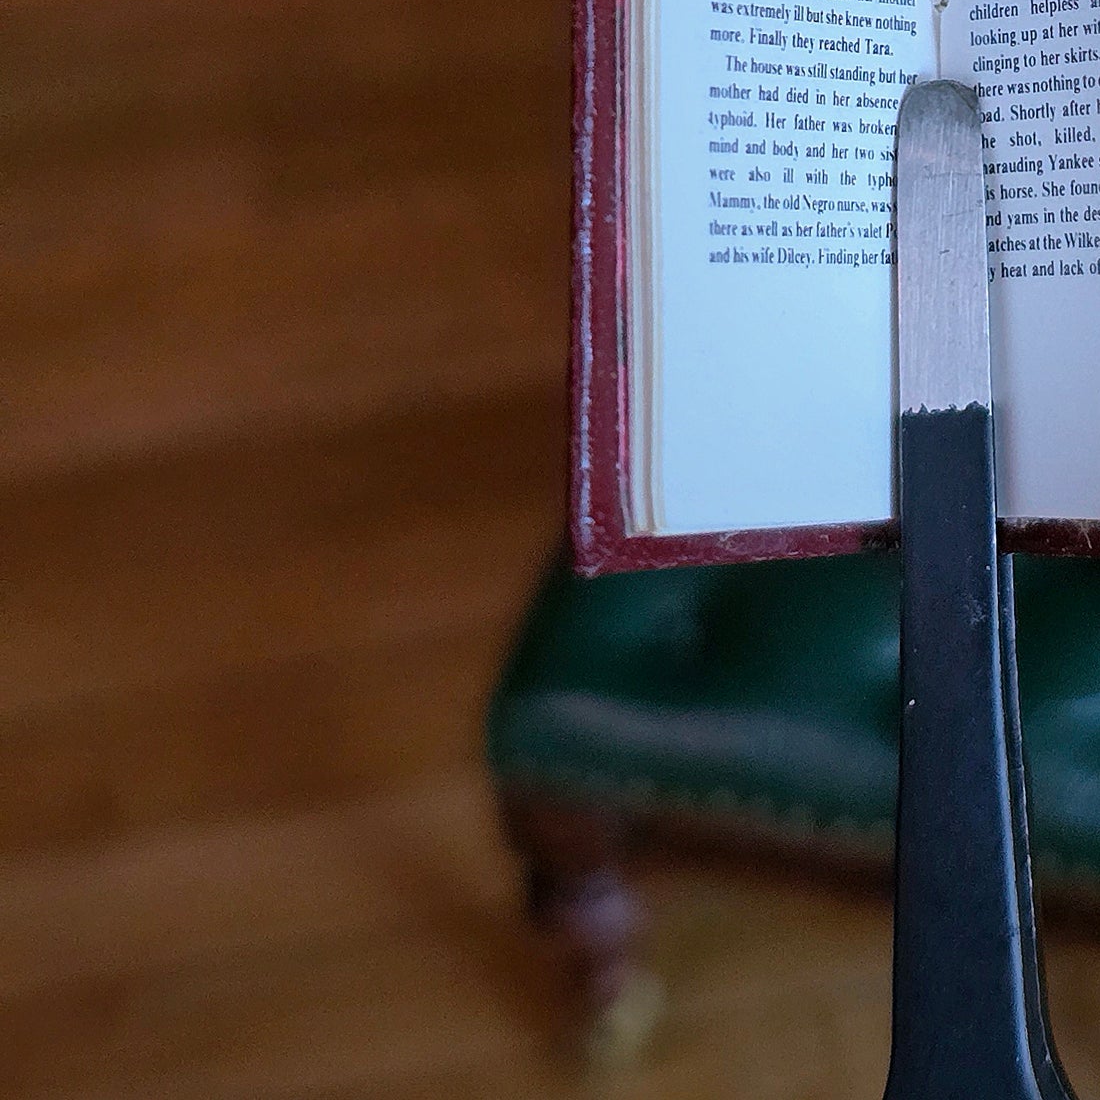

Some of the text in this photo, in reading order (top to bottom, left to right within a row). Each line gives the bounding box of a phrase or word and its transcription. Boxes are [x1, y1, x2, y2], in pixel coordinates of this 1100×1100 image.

[711, 0, 917, 36] was extremely ill but she knew nothing
[969, 3, 1019, 21] children
[709, 27, 894, 56] more. Finally they reached Tara.
[970, 29, 1018, 48] looking
[1021, 29, 1038, 46] up
[1042, 26, 1055, 40] at
[1058, 21, 1079, 38] her
[725, 55, 918, 86] The house was still standing but her
[972, 54, 1020, 75] clinging
[1023, 52, 1037, 69] to
[1040, 49, 1061, 66] her
[709, 83, 899, 109] mother had died in her absence
[973, 80, 1004, 98] there
[1007, 78, 1031, 94] was
[1032, 73, 1080, 94] nothing
[1082, 73, 1096, 89] to
[708, 111, 897, 136] typhoid. Her father was broken
[1010, 102, 1056, 123] Shortly
[1062, 101, 1091, 118] after
[709, 137, 739, 154] mind
[745, 139, 766, 155] and
[772, 140, 799, 161] body
[805, 143, 825, 158] and
[831, 144, 850, 159] her
[855, 146, 875, 160] two
[981, 131, 996, 150] he
[1009, 132, 1042, 148] shot,
[1054, 126, 1096, 145] killed,
[1048, 152, 1094, 171] Yankee
[709, 169, 736, 181] were
[748, 166, 771, 181] also
[783, 167, 794, 183] ill
[805, 168, 829, 185] with
[840, 170, 857, 186] the
[1000, 182, 1037, 199] horse.
[1041, 180, 1066, 197] She
[709, 192, 761, 213] Mammy,
[763, 193, 781, 209] the
[783, 195, 800, 210] old
[802, 195, 835, 215] Negro
[837, 201, 869, 213] nurse,
[871, 201, 891, 213] was
[1007, 210, 1039, 229] yams
[1043, 207, 1056, 224] in
[1060, 206, 1079, 223] the
[709, 220, 737, 236] there
[741, 225, 753, 236] as
[756, 220, 778, 237] well
[781, 225, 793, 237] as
[796, 221, 813, 237] her
[816, 221, 855, 238] father's
[857, 223, 884, 239] valet
[988, 233, 1027, 253] atches
[1029, 235, 1041, 250] at
[1043, 232, 1062, 250] the
[709, 247, 731, 263] and
[733, 247, 749, 263] his
[752, 247, 774, 264] wife
[777, 247, 815, 269] Dilcey.
[818, 248, 860, 267] Finding
[861, 248, 879, 265] her
[1001, 260, 1027, 279] heat
[1032, 259, 1055, 277] and
[1059, 258, 1084, 275] lack
